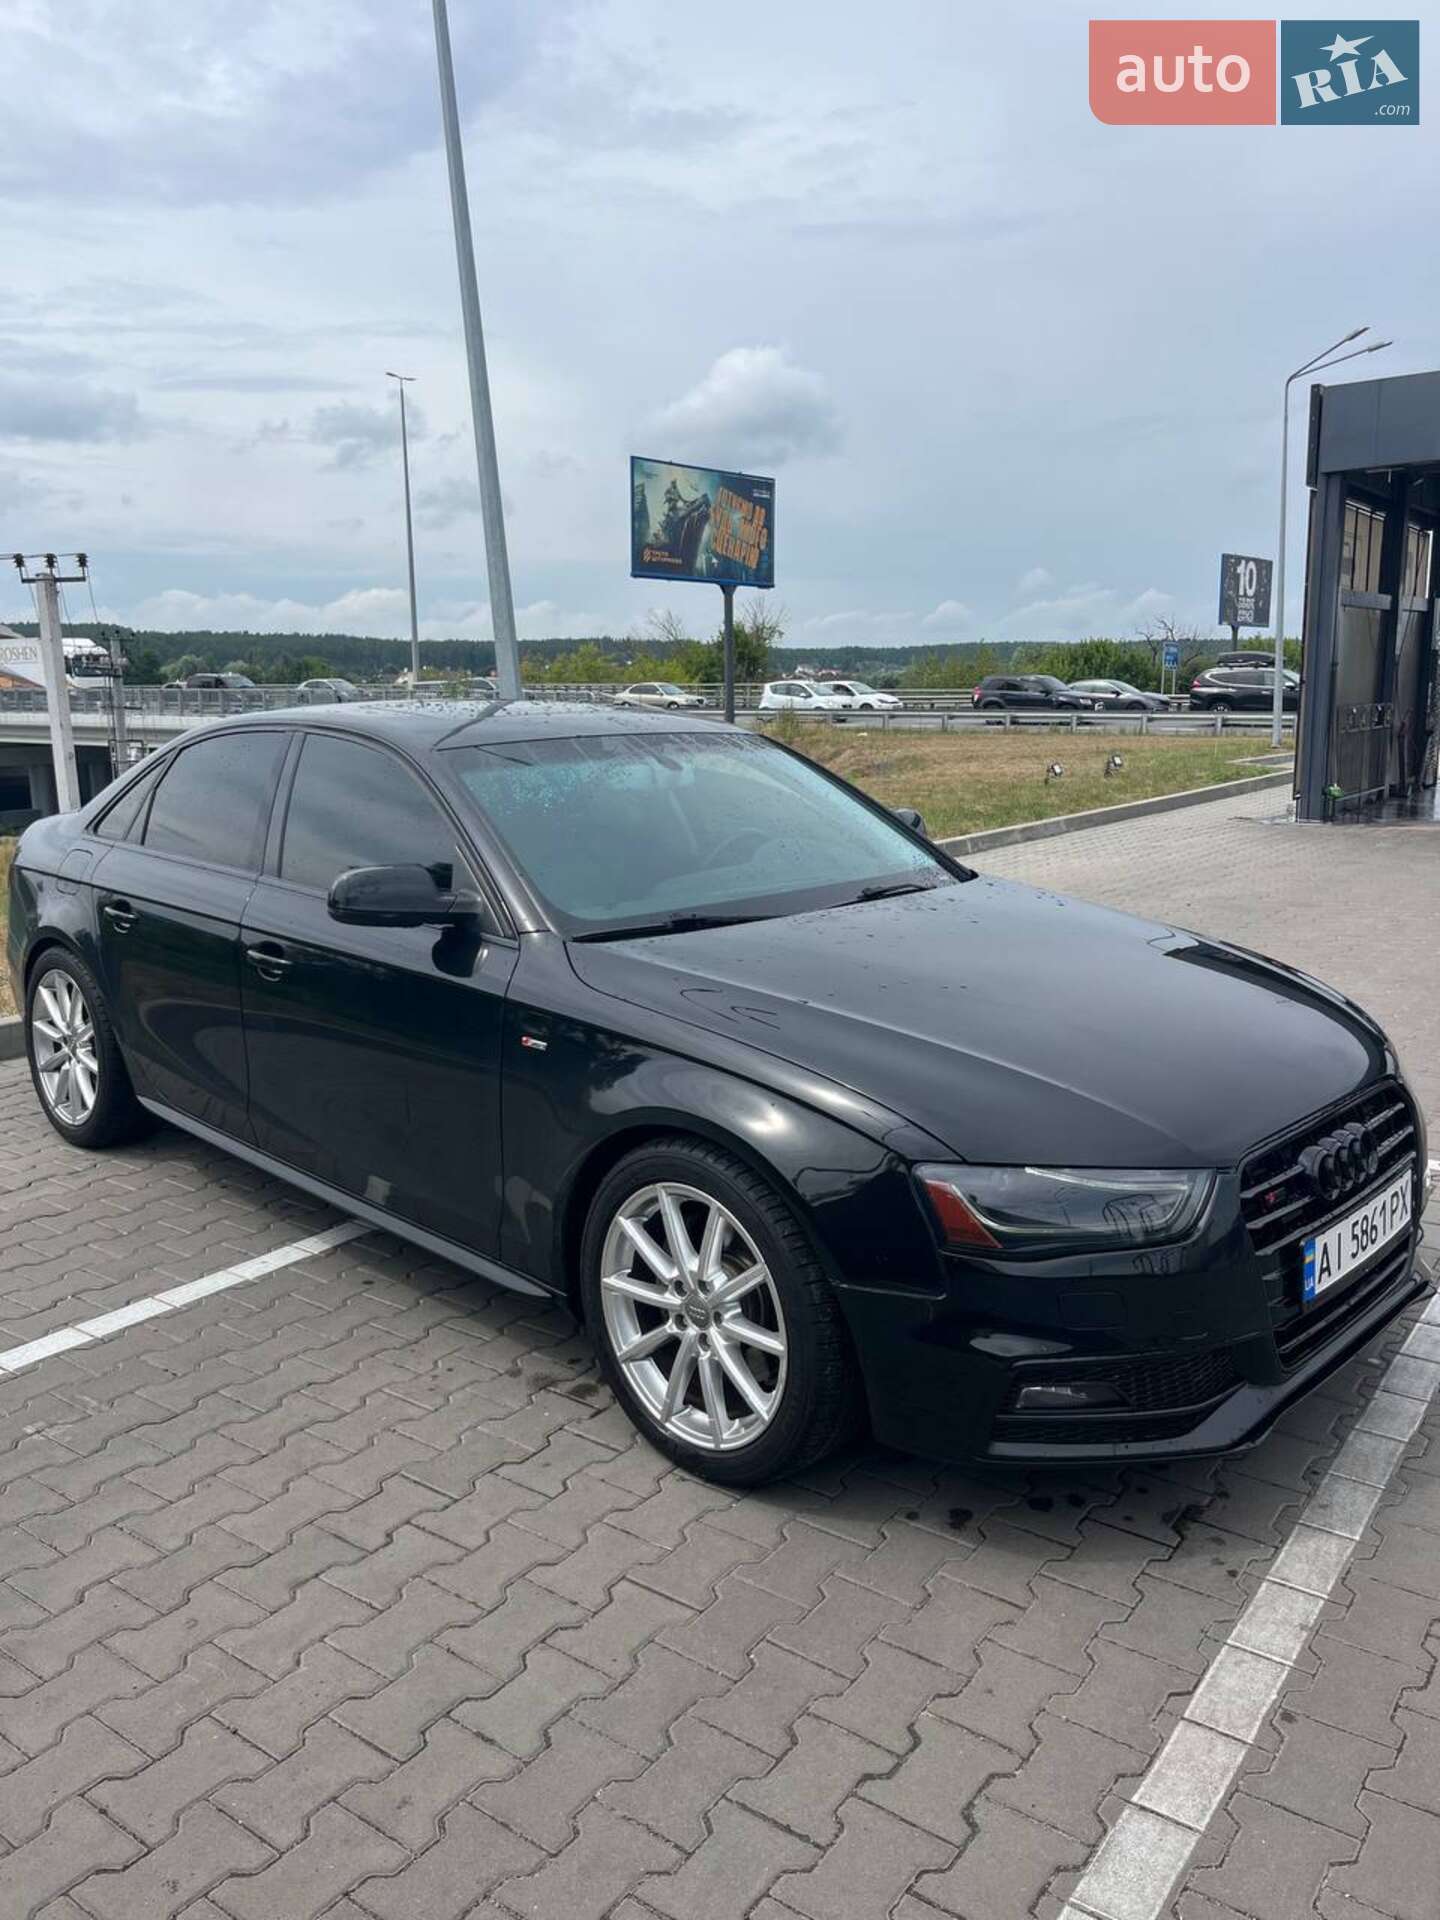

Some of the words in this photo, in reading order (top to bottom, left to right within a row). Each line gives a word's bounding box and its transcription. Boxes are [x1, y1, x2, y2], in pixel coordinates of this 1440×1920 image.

[1236, 559, 1257, 596] 10
[1318, 1232, 1341, 1284] AI
[1351, 1200, 1387, 1259] 5861
